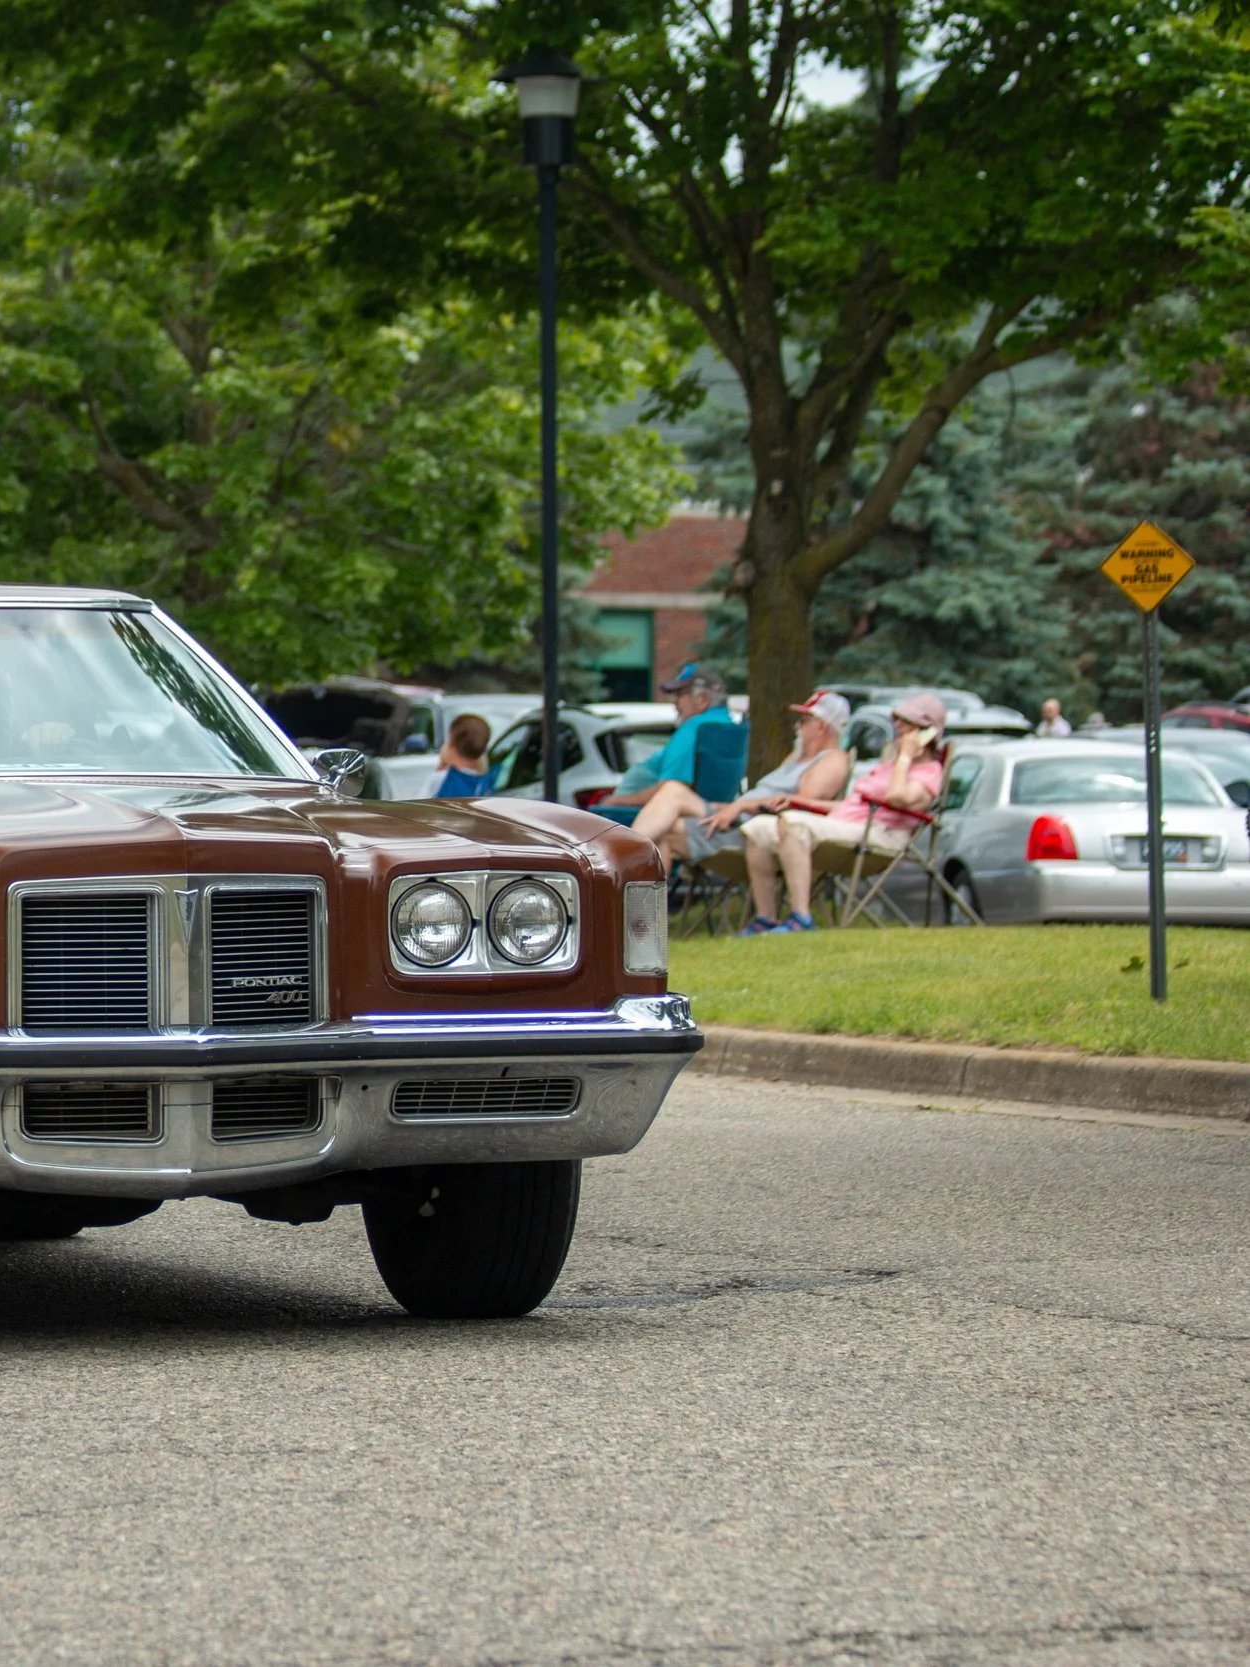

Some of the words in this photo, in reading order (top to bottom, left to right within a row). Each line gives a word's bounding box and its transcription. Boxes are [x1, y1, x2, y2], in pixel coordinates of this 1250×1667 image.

[1119, 548, 1174, 559] WARNING
[232, 976, 302, 988] PONTIAC
[265, 990, 303, 1003] 400
